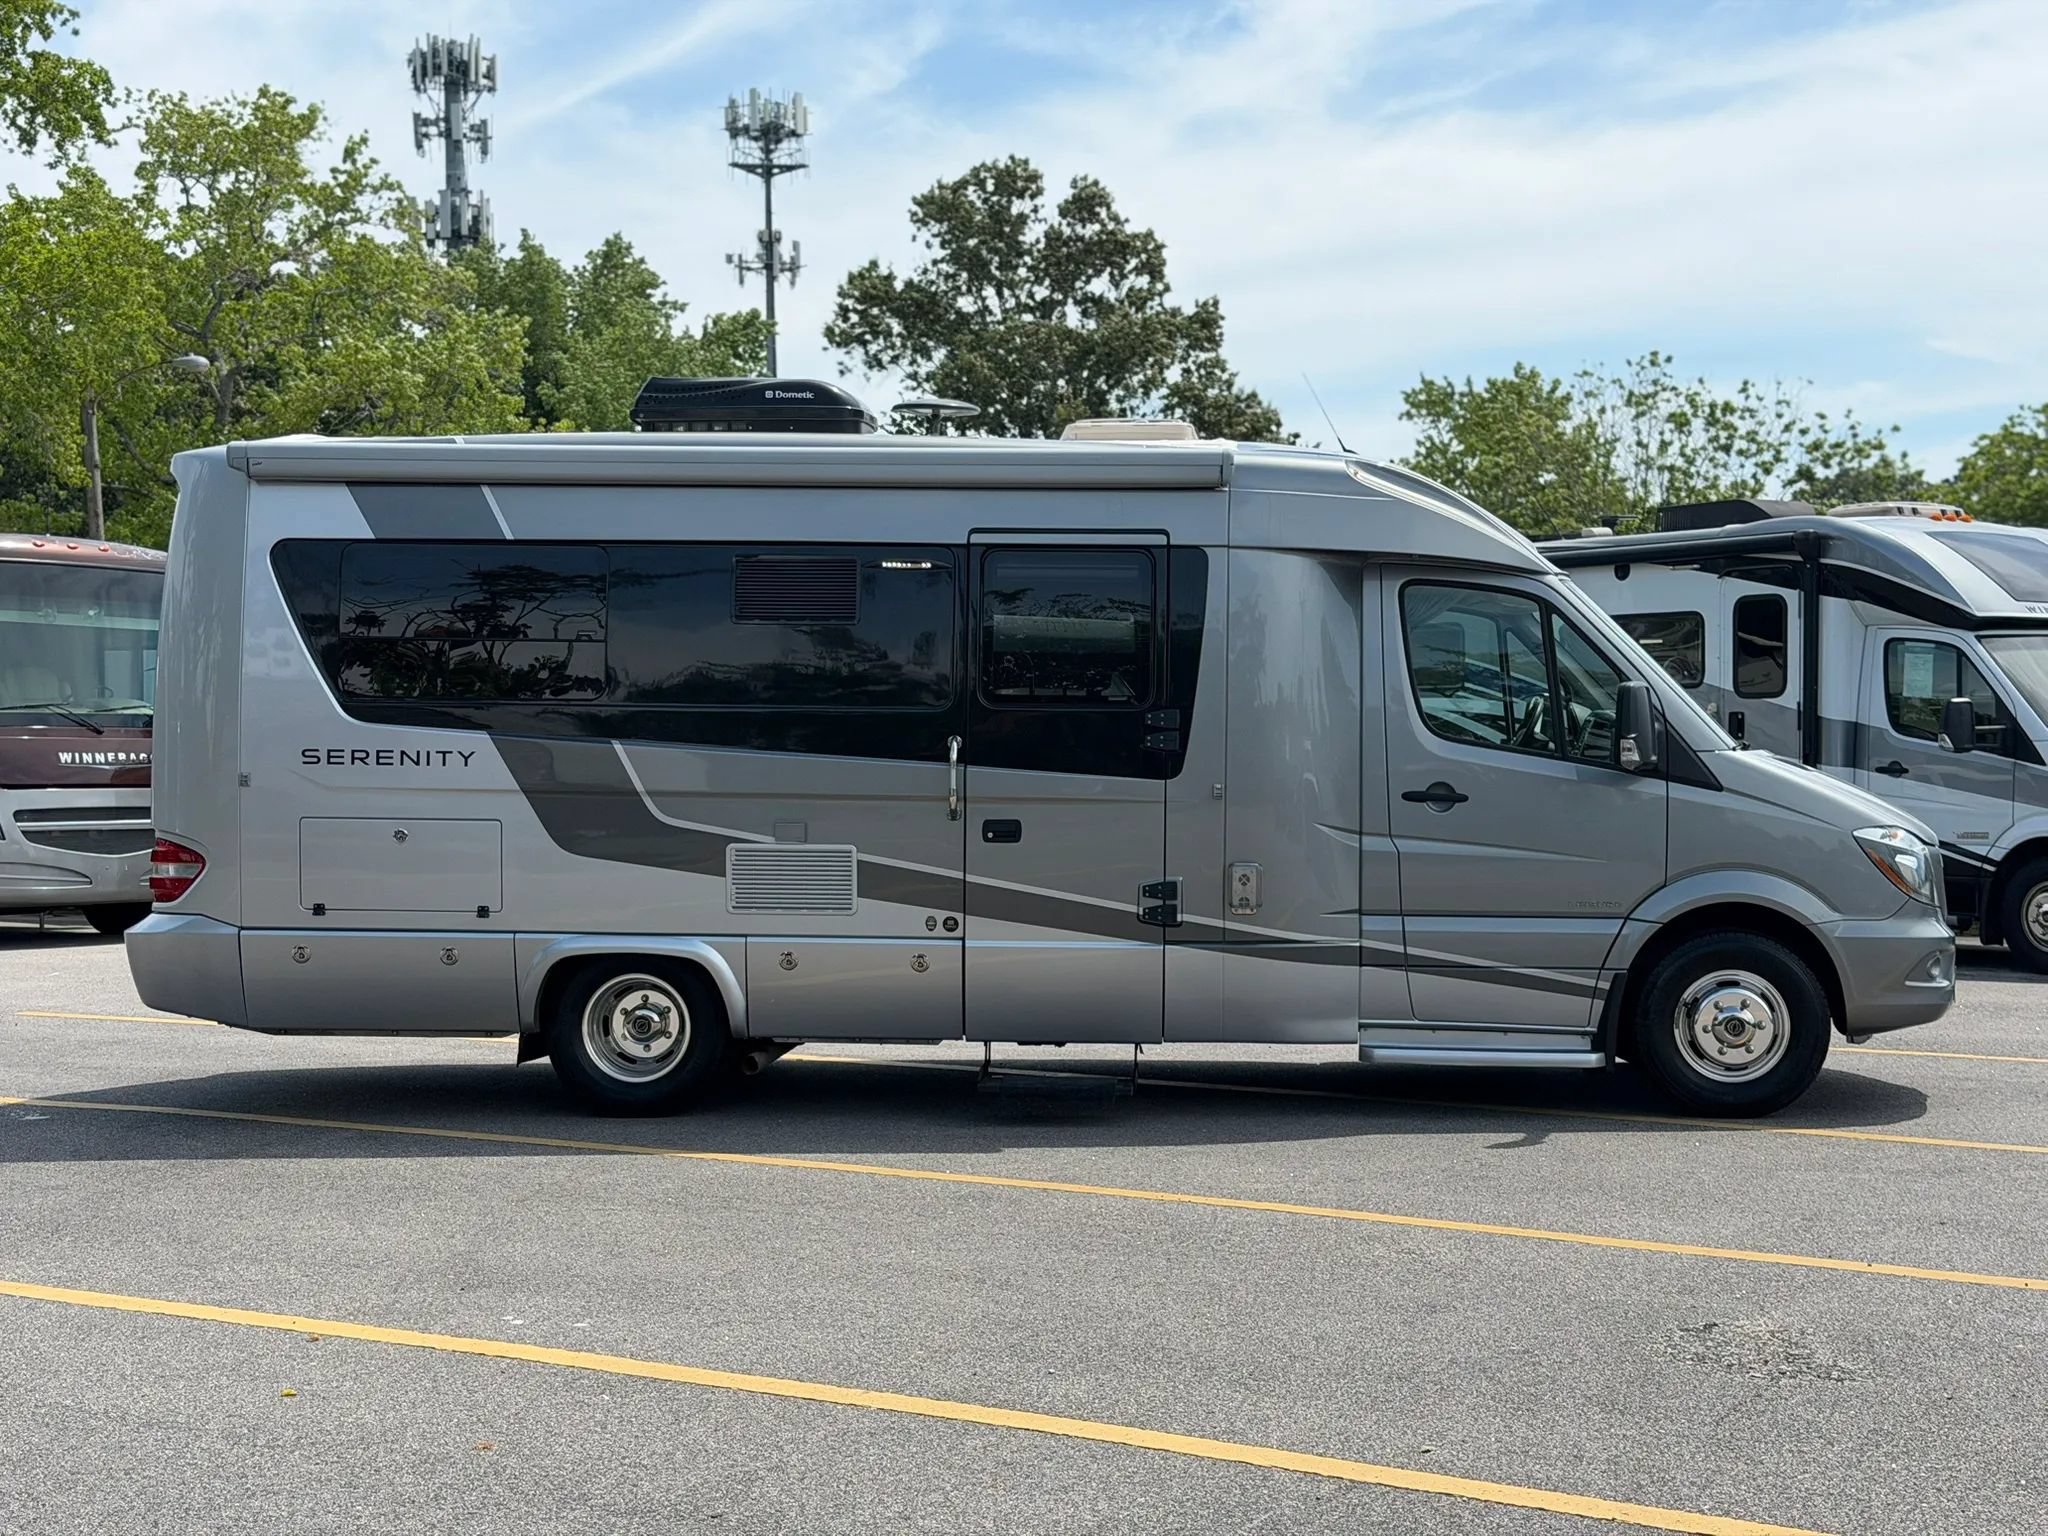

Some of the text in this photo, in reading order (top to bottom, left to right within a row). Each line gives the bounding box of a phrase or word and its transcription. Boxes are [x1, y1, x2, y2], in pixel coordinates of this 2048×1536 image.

[775, 390, 815, 399] Dometic
[58, 751, 152, 764] WINNEBAG
[301, 748, 476, 767] SERENITY
